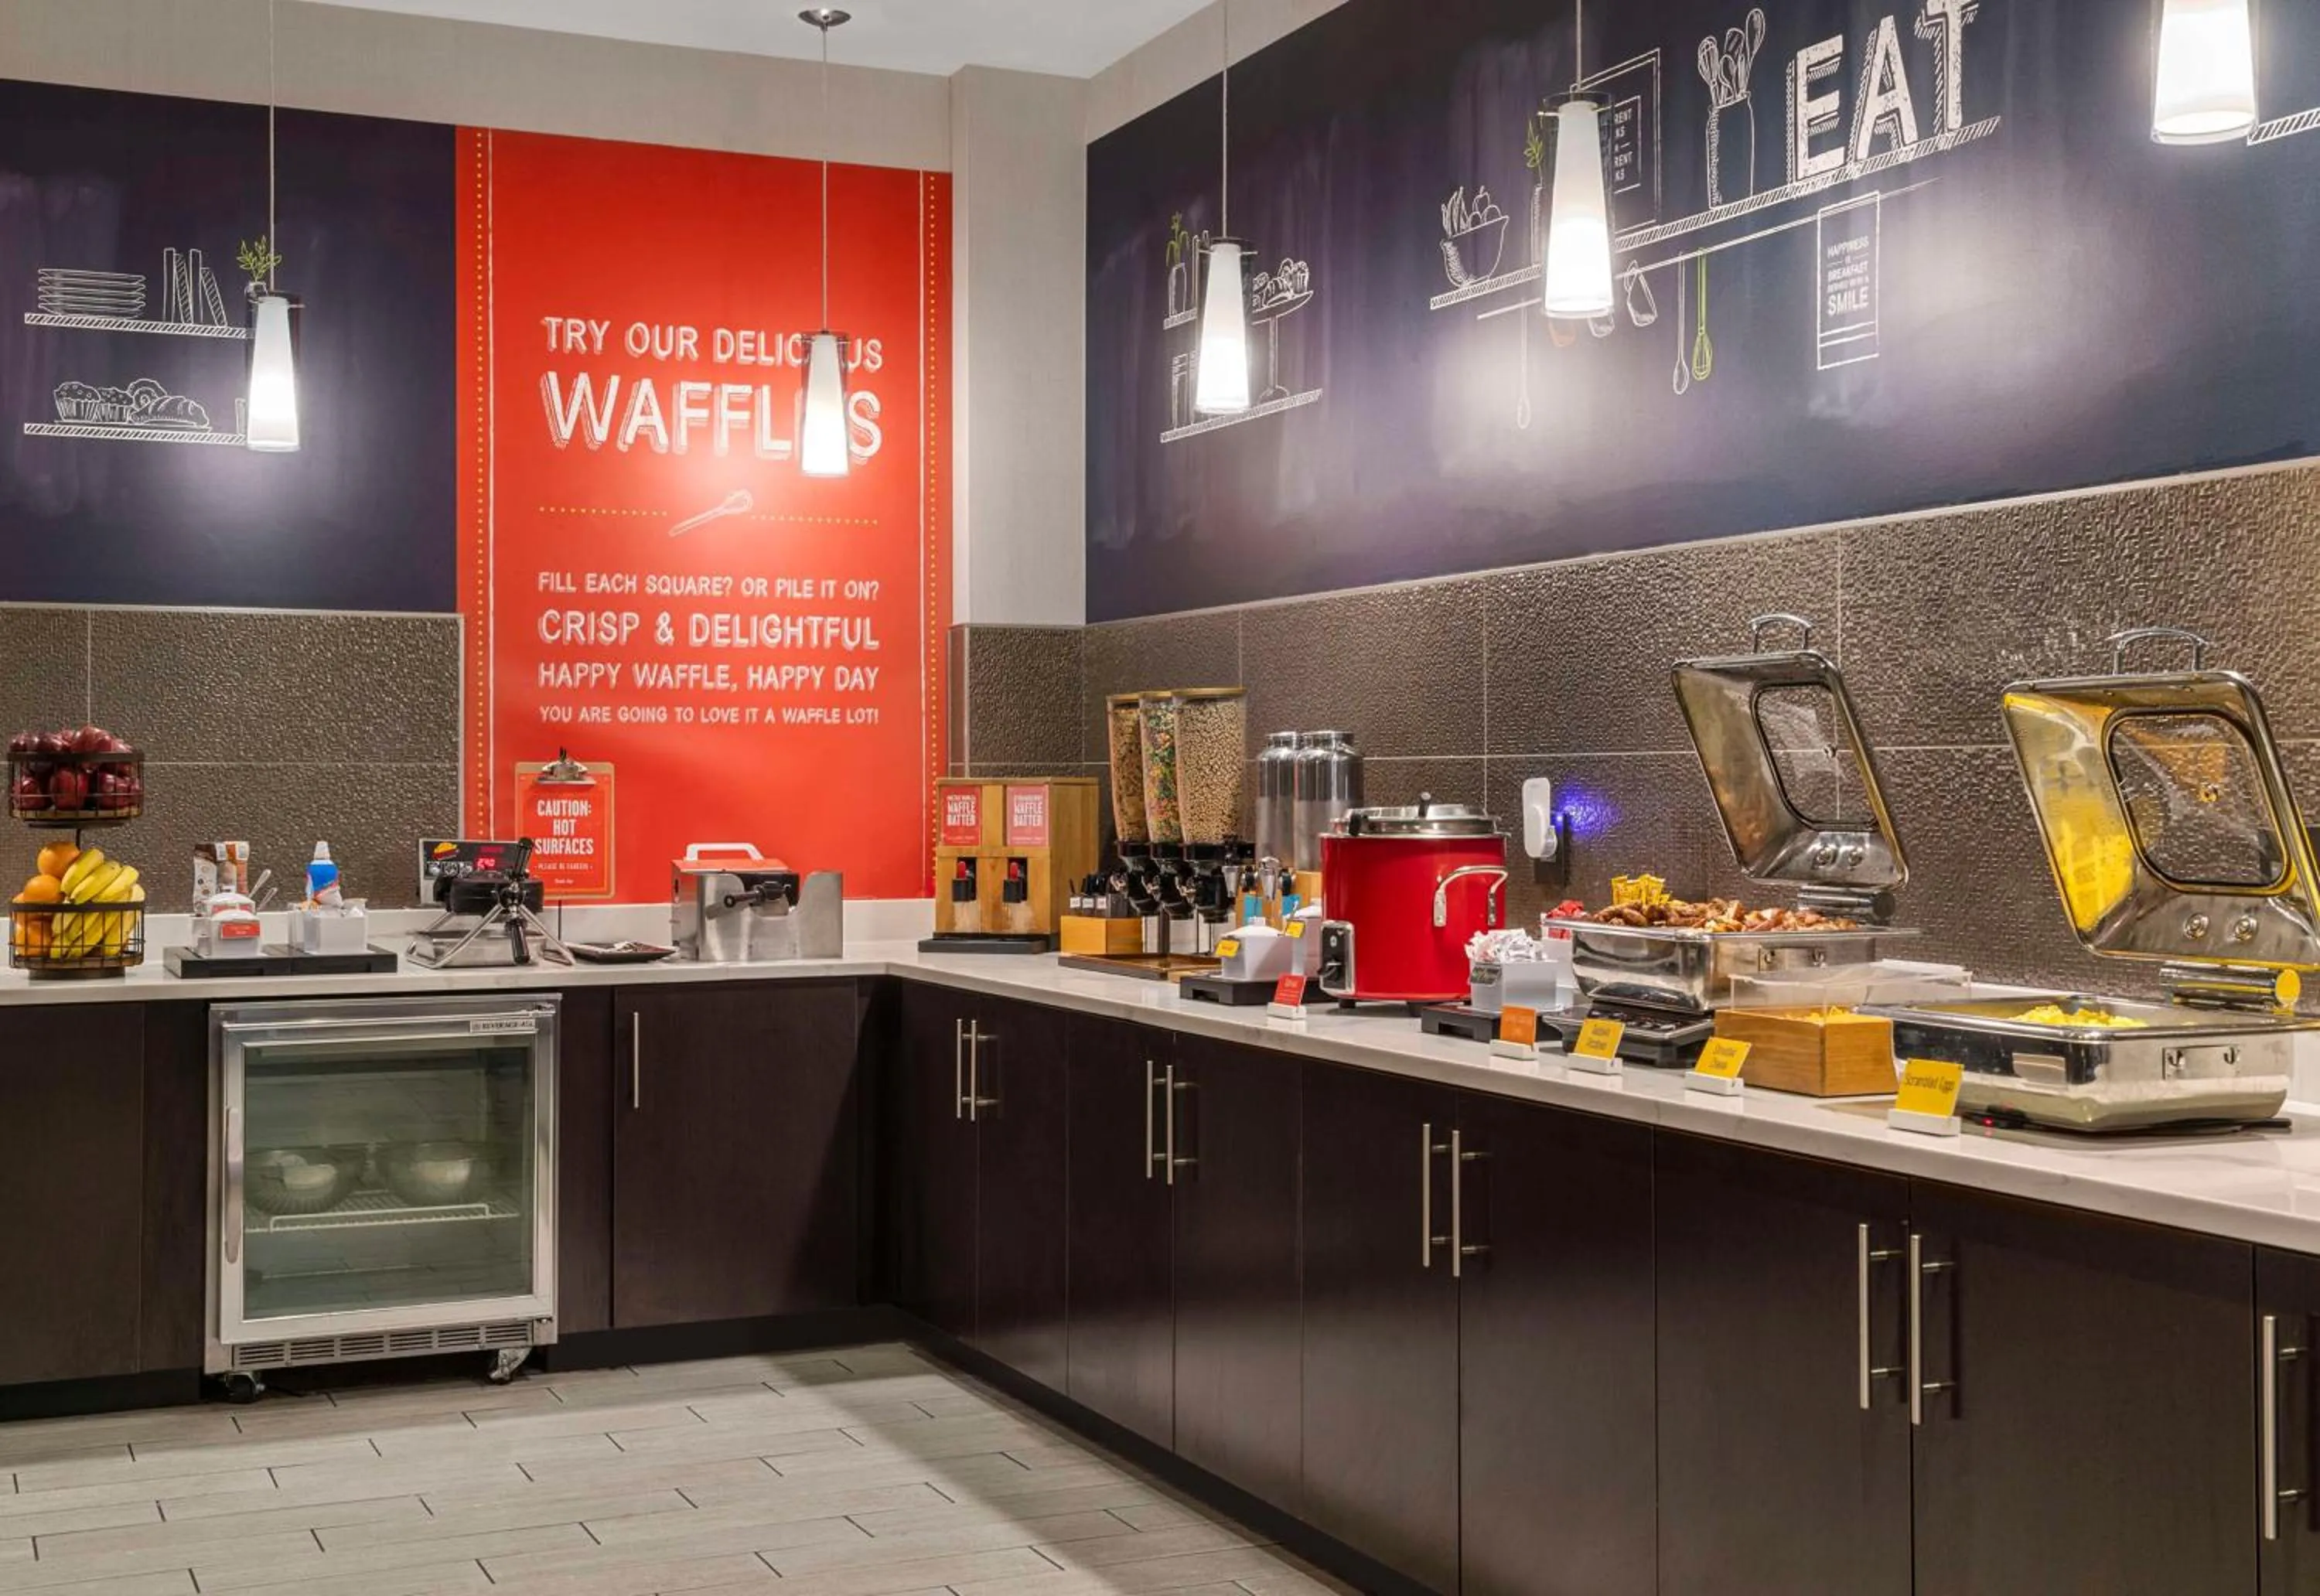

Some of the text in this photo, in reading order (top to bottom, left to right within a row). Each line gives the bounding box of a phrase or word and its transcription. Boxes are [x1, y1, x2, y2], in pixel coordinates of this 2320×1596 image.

[1786, 0, 1980, 184] EAT
[1827, 261, 1868, 282] BREAKFAST
[1827, 285, 1869, 316] SMILE
[541, 316, 883, 372] TRY OUR DELICUS
[541, 370, 883, 464] WAFFLS
[538, 572, 879, 600] FILL EACH SQUARE? OR PILE IT ON?
[538, 609, 879, 650] CRISP & DELIGHTFUL
[538, 662, 879, 692] HAPPY WAFFLE, HAPPY DAY
[540, 705, 879, 725] YOU ARE GOING TO LOVE IT A WAFFLE LOT!
[537, 799, 592, 817] CAUTION:
[947, 801, 976, 814] WAFFLE
[1013, 802, 1043, 814] WAFFLE
[552, 819, 577, 836] HOT
[947, 814, 976, 827] BATTER
[1013, 814, 1043, 827] BATTER
[534, 837, 594, 854] SURFACES
